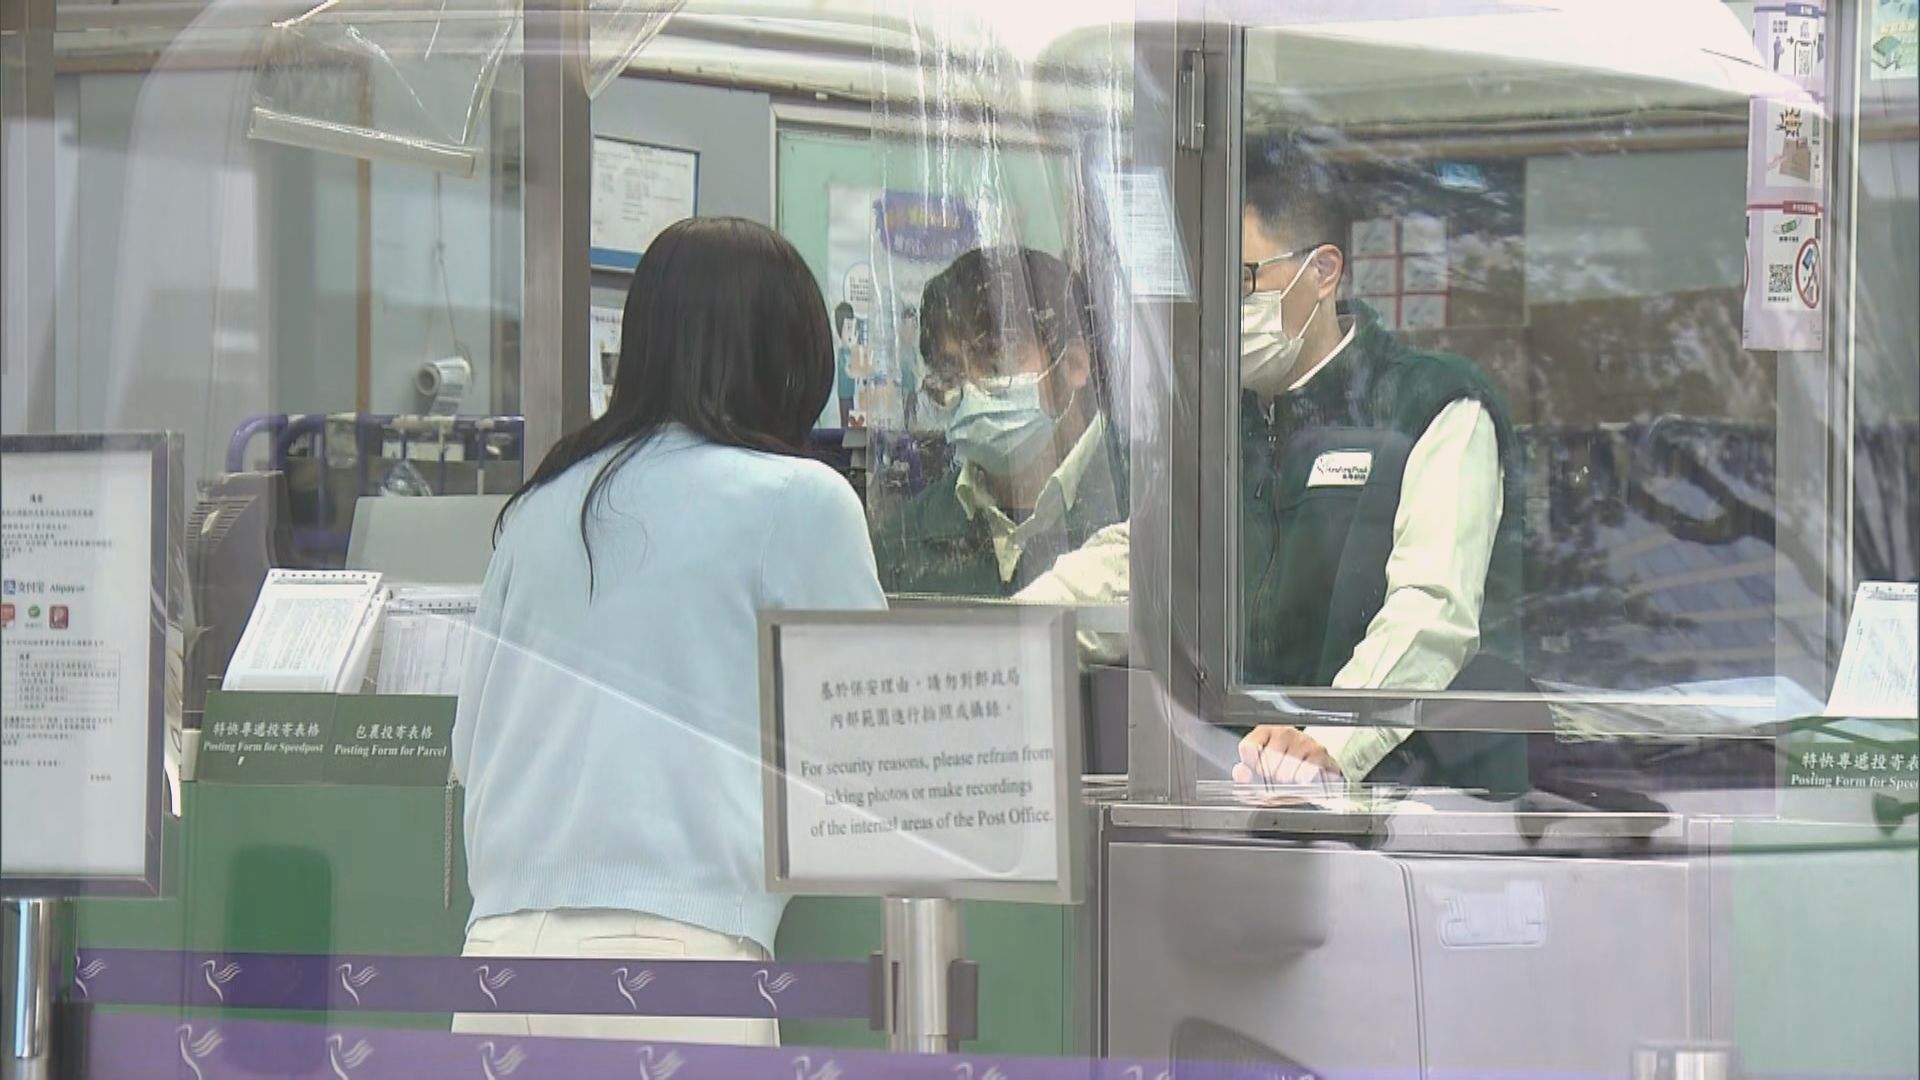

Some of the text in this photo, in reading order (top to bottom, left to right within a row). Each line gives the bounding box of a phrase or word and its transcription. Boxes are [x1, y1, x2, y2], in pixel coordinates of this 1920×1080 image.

[355, 723, 433, 740] 包裹投寄表格
[203, 741, 324, 755] Posting Form for Speedpost
[334, 743, 447, 758] Posting Form for Parcel
[800, 745, 1054, 777] For security reasons, please refrain from
[1791, 773, 1832, 789] Posting
[1835, 776, 1866, 787] Form
[1870, 776, 1886, 788] for
[867, 786, 909, 807] photos
[911, 788, 925, 800] or
[928, 781, 963, 799] make
[966, 779, 1033, 797] recordings
[810, 820, 825, 837] of
[827, 820, 847, 835] the
[901, 817, 933, 831] areas
[936, 812, 952, 829] of
[953, 811, 974, 827] the
[977, 810, 1006, 826] Post
[1008, 806, 1053, 824] Office.
